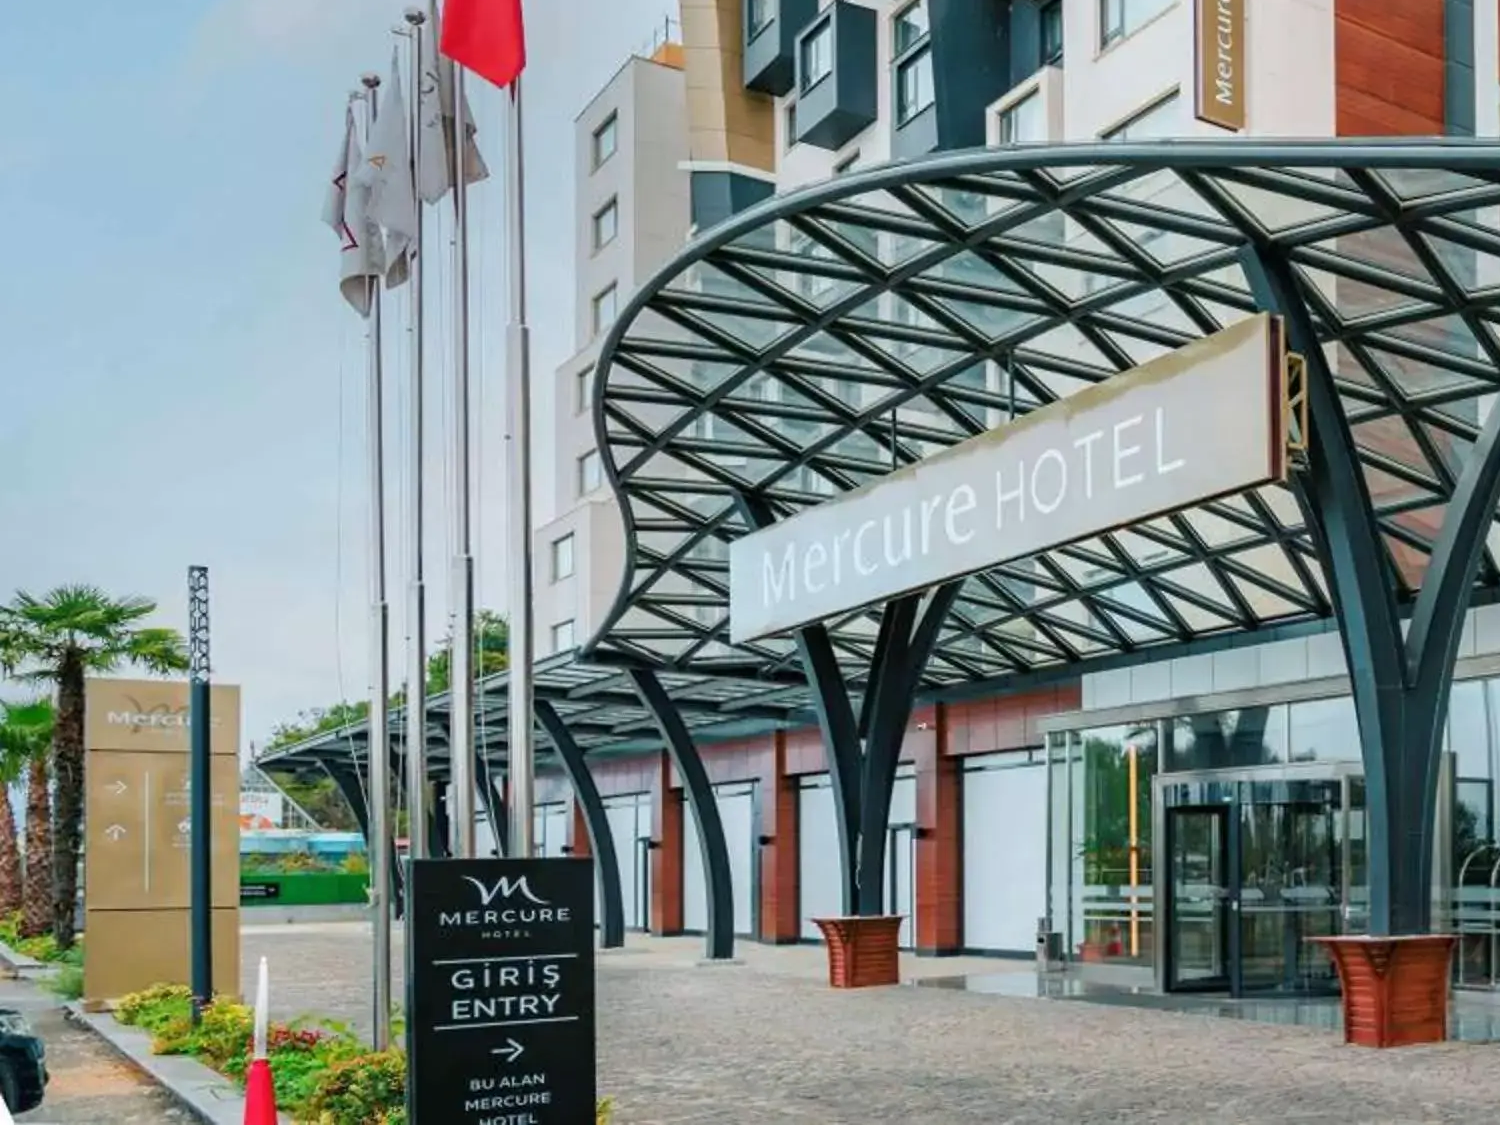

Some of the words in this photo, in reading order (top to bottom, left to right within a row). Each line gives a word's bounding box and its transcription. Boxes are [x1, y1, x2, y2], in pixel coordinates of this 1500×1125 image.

[761, 482, 977, 608] Mercure
[995, 406, 1186, 530] HOTEL
[440, 908, 572, 926] MERCURE
[481, 929, 533, 938] HOTEL
[451, 959, 561, 989] GİRİŞ
[452, 993, 561, 1020] ENTRY
[469, 1078, 495, 1091] BU
[499, 1073, 546, 1088] ALAN
[464, 1091, 552, 1112] MERCURE
